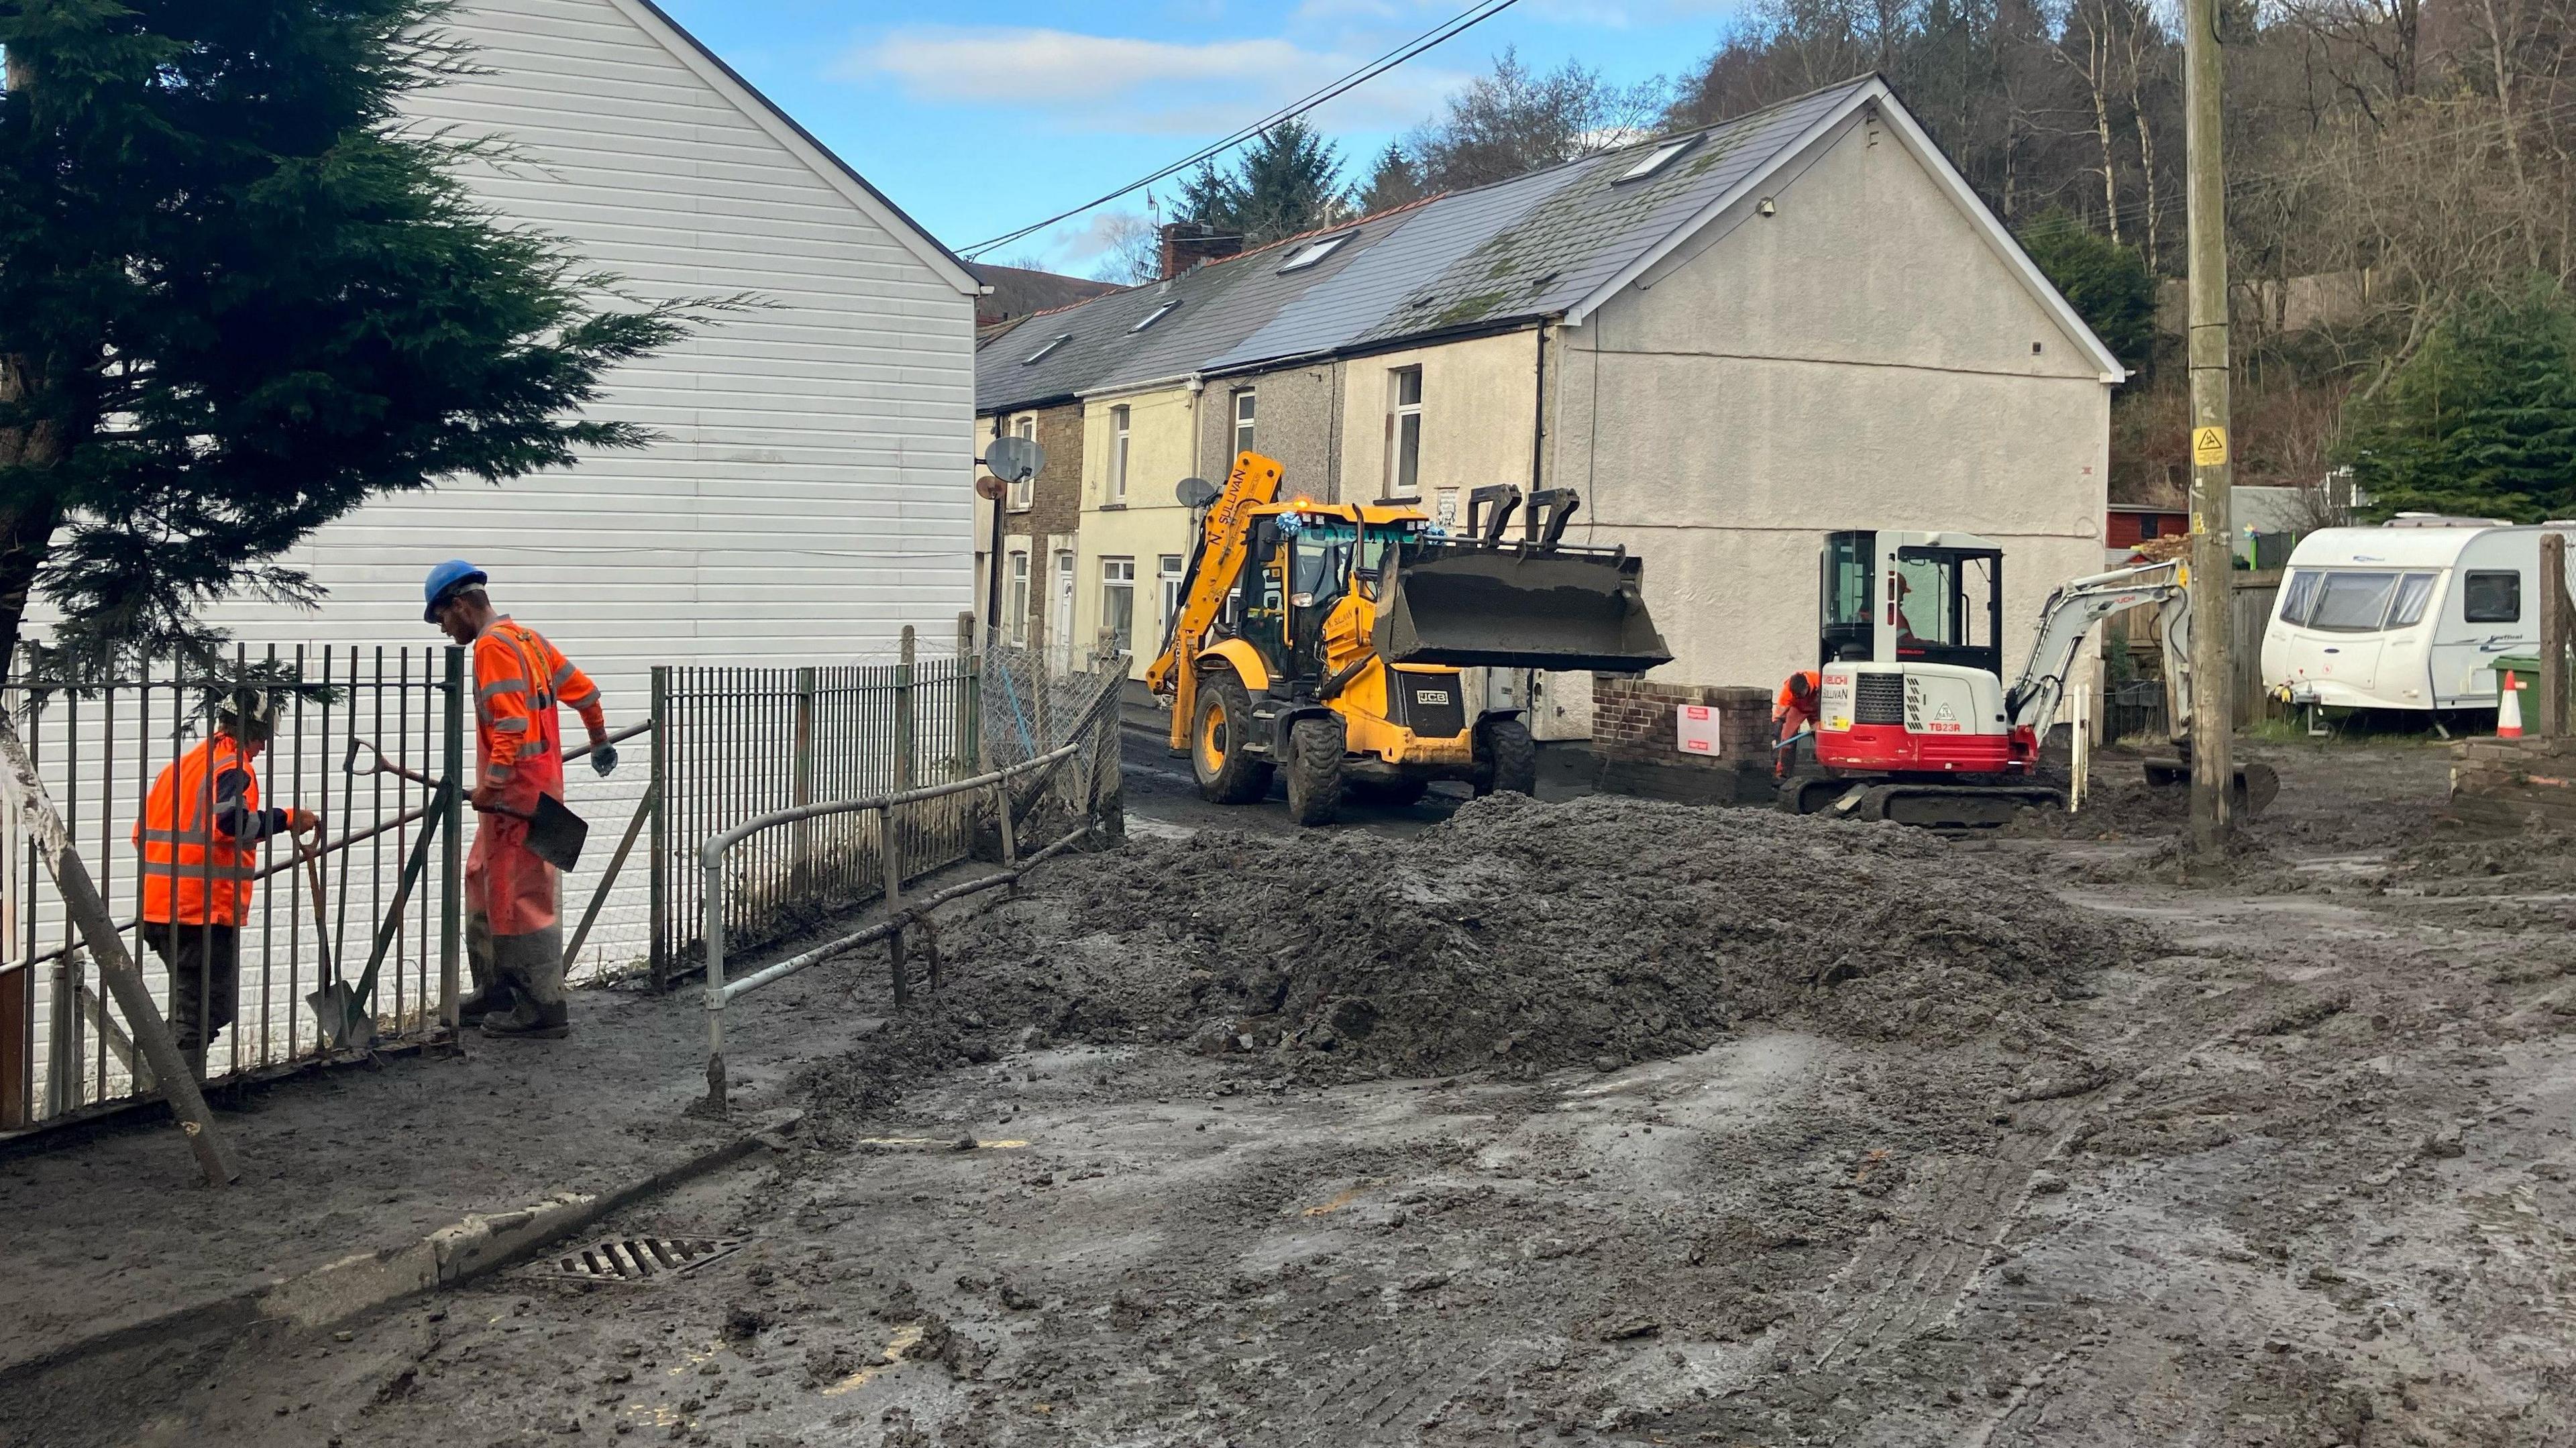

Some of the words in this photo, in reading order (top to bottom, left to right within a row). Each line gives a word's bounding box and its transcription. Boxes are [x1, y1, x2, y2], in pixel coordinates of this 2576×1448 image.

[1219, 469, 1246, 525] SULLIVAN
[1419, 692, 1446, 702] JCB
[1929, 723, 1960, 732] TB23R
